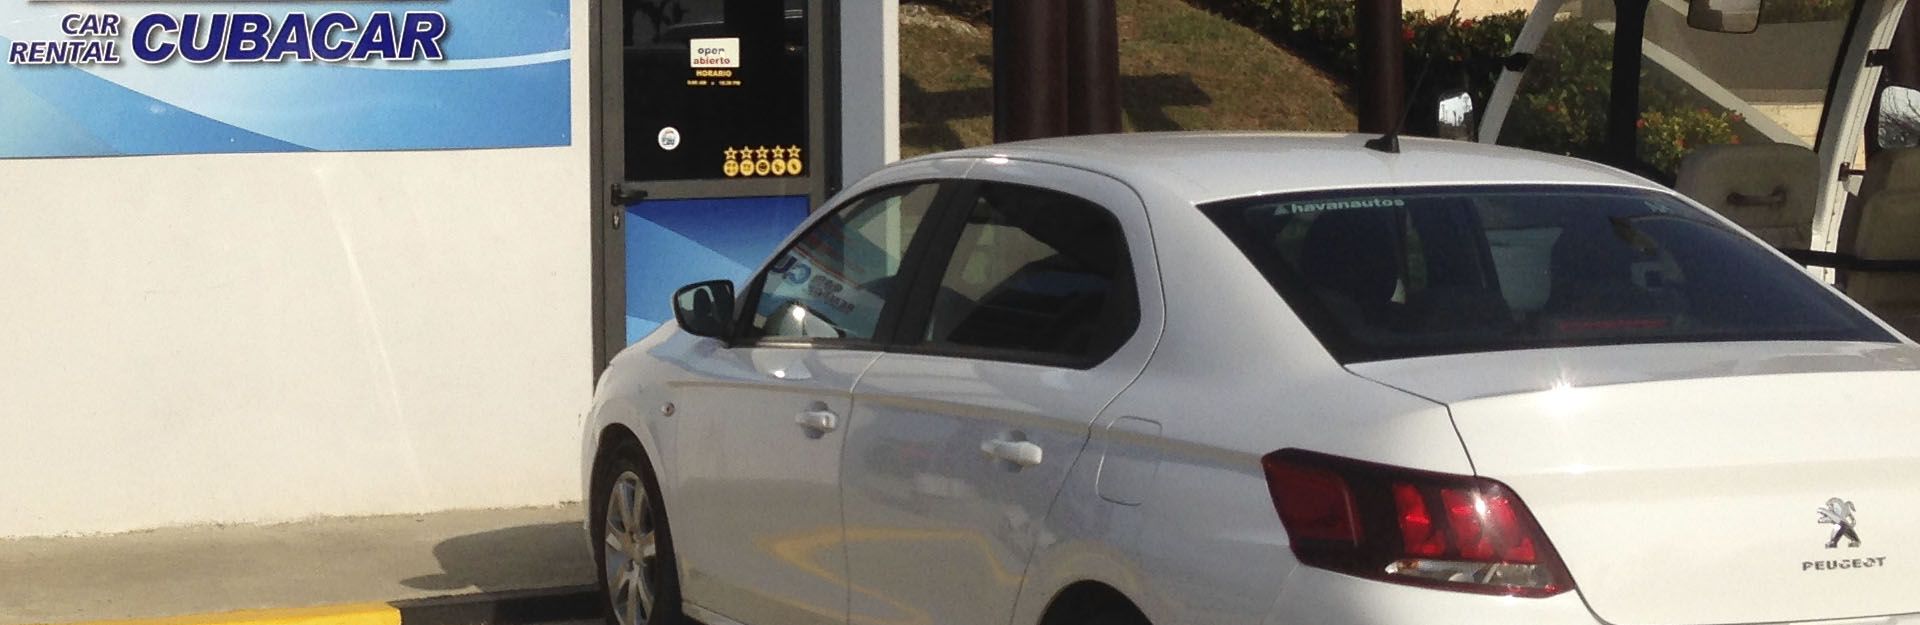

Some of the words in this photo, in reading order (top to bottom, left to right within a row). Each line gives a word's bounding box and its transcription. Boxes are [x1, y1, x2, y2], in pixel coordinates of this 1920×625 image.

[61, 13, 119, 36] CAR
[131, 11, 446, 64] CUBACAR
[8, 41, 120, 64] RENTAL
[1291, 198, 1405, 213] havanautos
[1802, 556, 1887, 571] PEUGEOT
